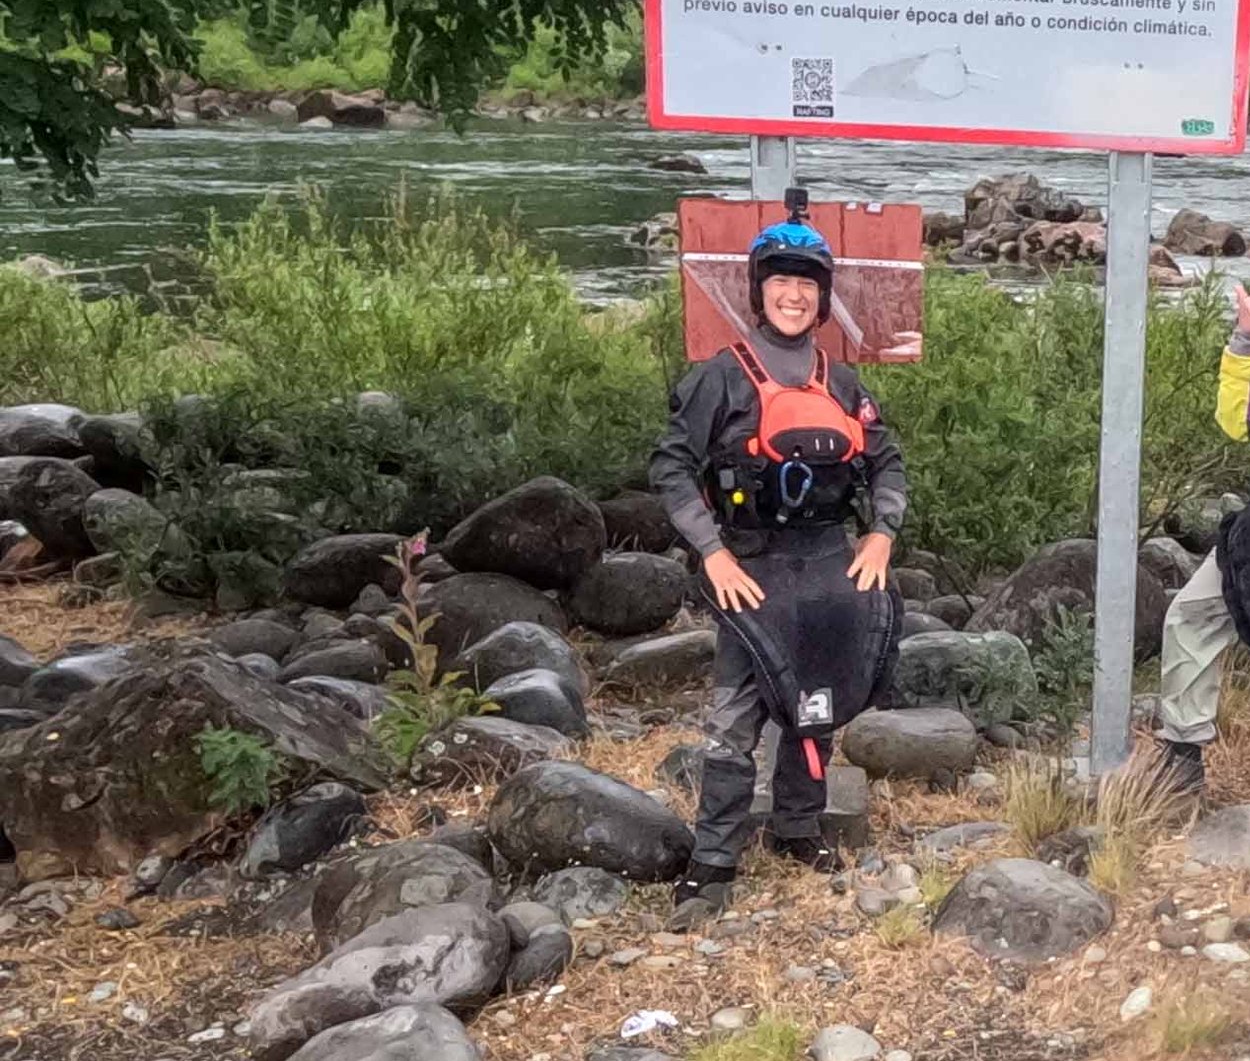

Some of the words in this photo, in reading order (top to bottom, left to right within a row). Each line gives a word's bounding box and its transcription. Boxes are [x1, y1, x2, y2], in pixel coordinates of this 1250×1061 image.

[743, 0, 788, 15] aviso
[794, 4, 814, 16] en
[820, 3, 900, 22] cualquier
[905, 5, 958, 24] época
[963, 10, 989, 25] del
[994, 11, 1025, 27] año
[1030, 16, 1041, 28] o
[1047, 15, 1128, 33] condición
[1133, 19, 1212, 37] climática.
